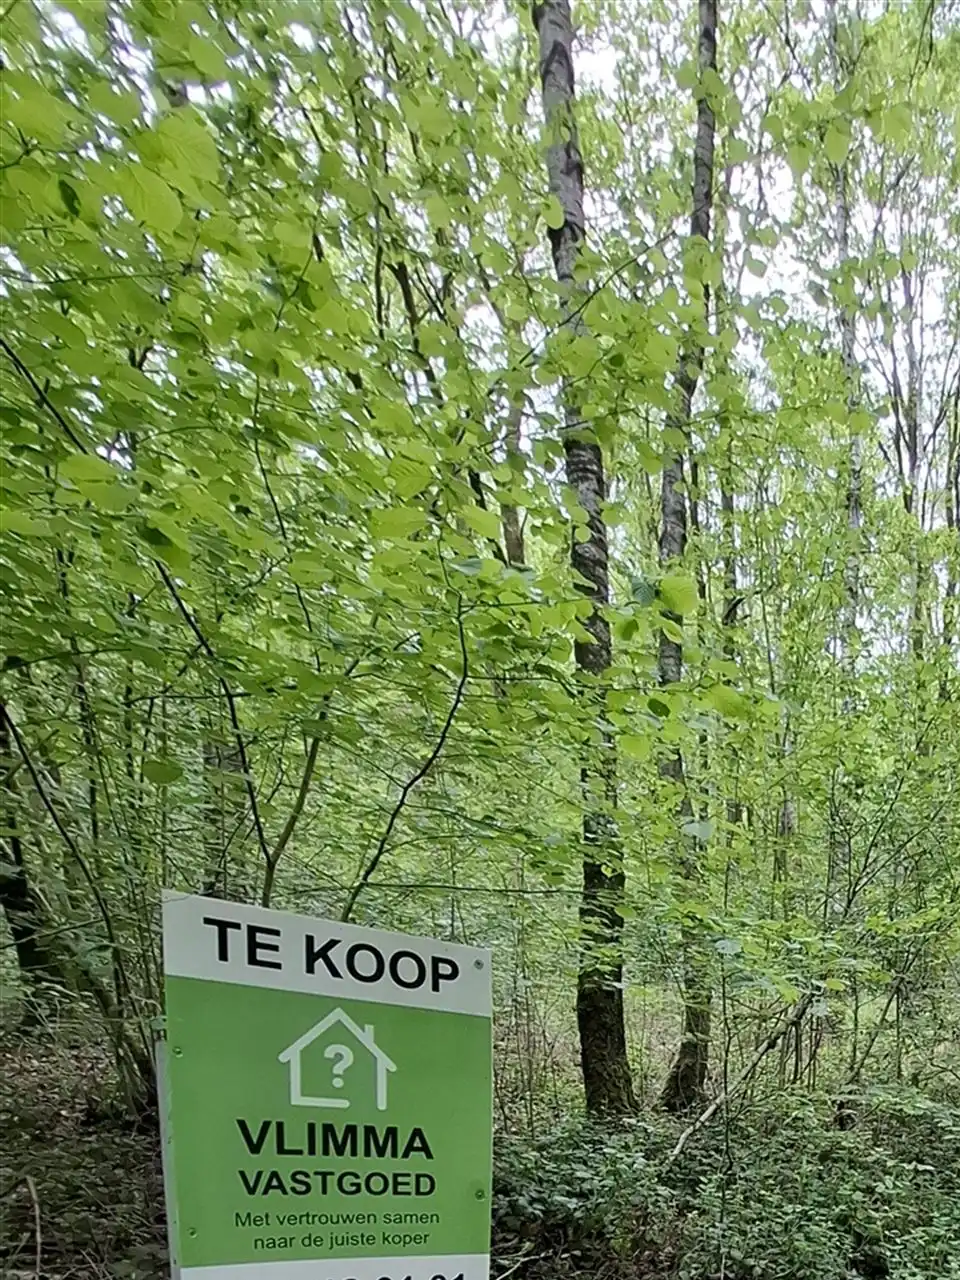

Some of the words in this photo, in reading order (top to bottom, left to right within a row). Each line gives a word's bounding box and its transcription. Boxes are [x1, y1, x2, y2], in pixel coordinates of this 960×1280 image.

[203, 916, 283, 970] TE
[305, 934, 460, 992] KOOP
[236, 1118, 435, 1160] VLIMMA
[237, 1169, 436, 1196] VASTGOED
[235, 1211, 271, 1227] Met
[275, 1211, 377, 1226] vertrouwen
[382, 1212, 440, 1225] samen
[254, 1236, 296, 1250] naar
[300, 1232, 324, 1248] de
[328, 1231, 377, 1251] juiste
[382, 1231, 430, 1248] koper
